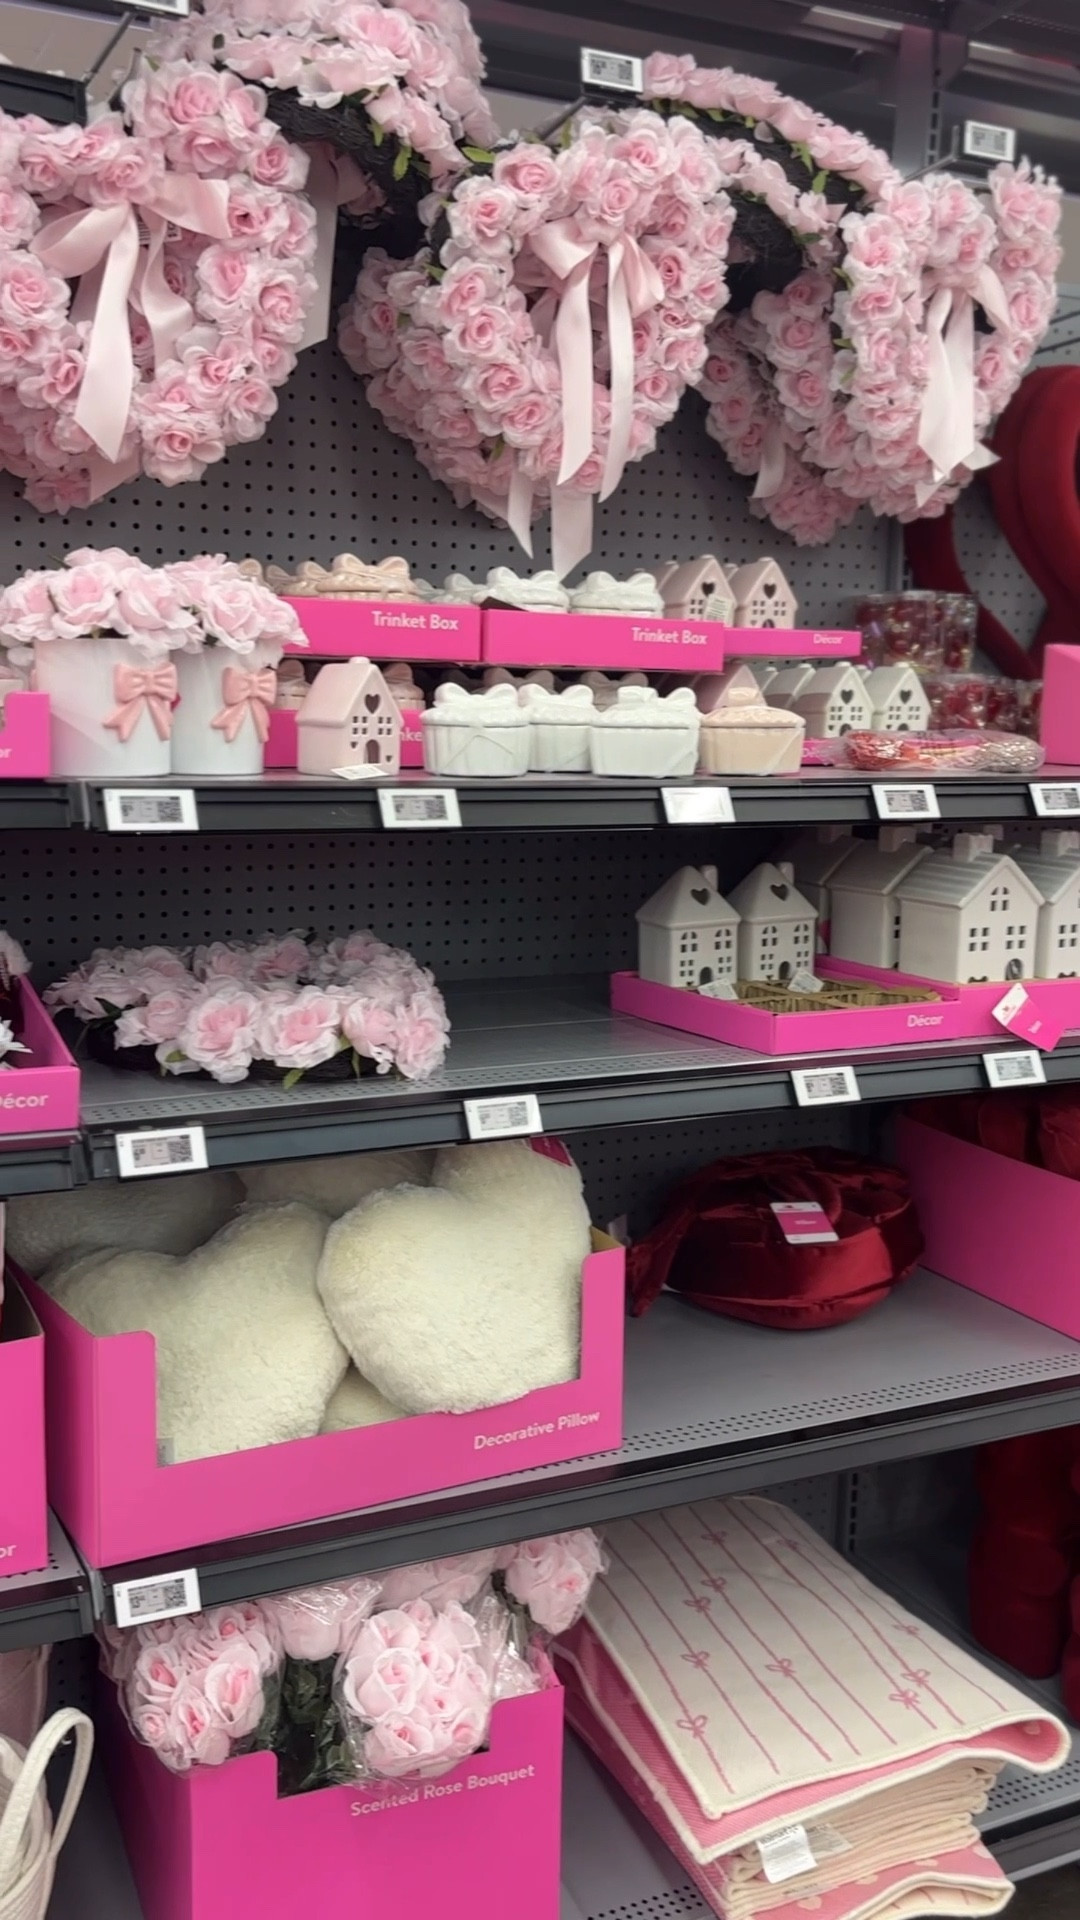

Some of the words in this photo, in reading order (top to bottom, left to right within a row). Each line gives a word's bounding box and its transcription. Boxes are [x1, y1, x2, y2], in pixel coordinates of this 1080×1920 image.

[371, 610, 427, 629] Trinket
[429, 613, 460, 631] Box
[631, 626, 679, 643] Trinket
[681, 629, 708, 645] Box
[907, 1014, 944, 1028] Décor
[473, 1421, 555, 1450] Decorative
[557, 1411, 600, 1431] Pillow
[350, 1788, 419, 1817] Scented
[423, 1782, 463, 1801] Rose
[467, 1764, 536, 1790] Bouquet
